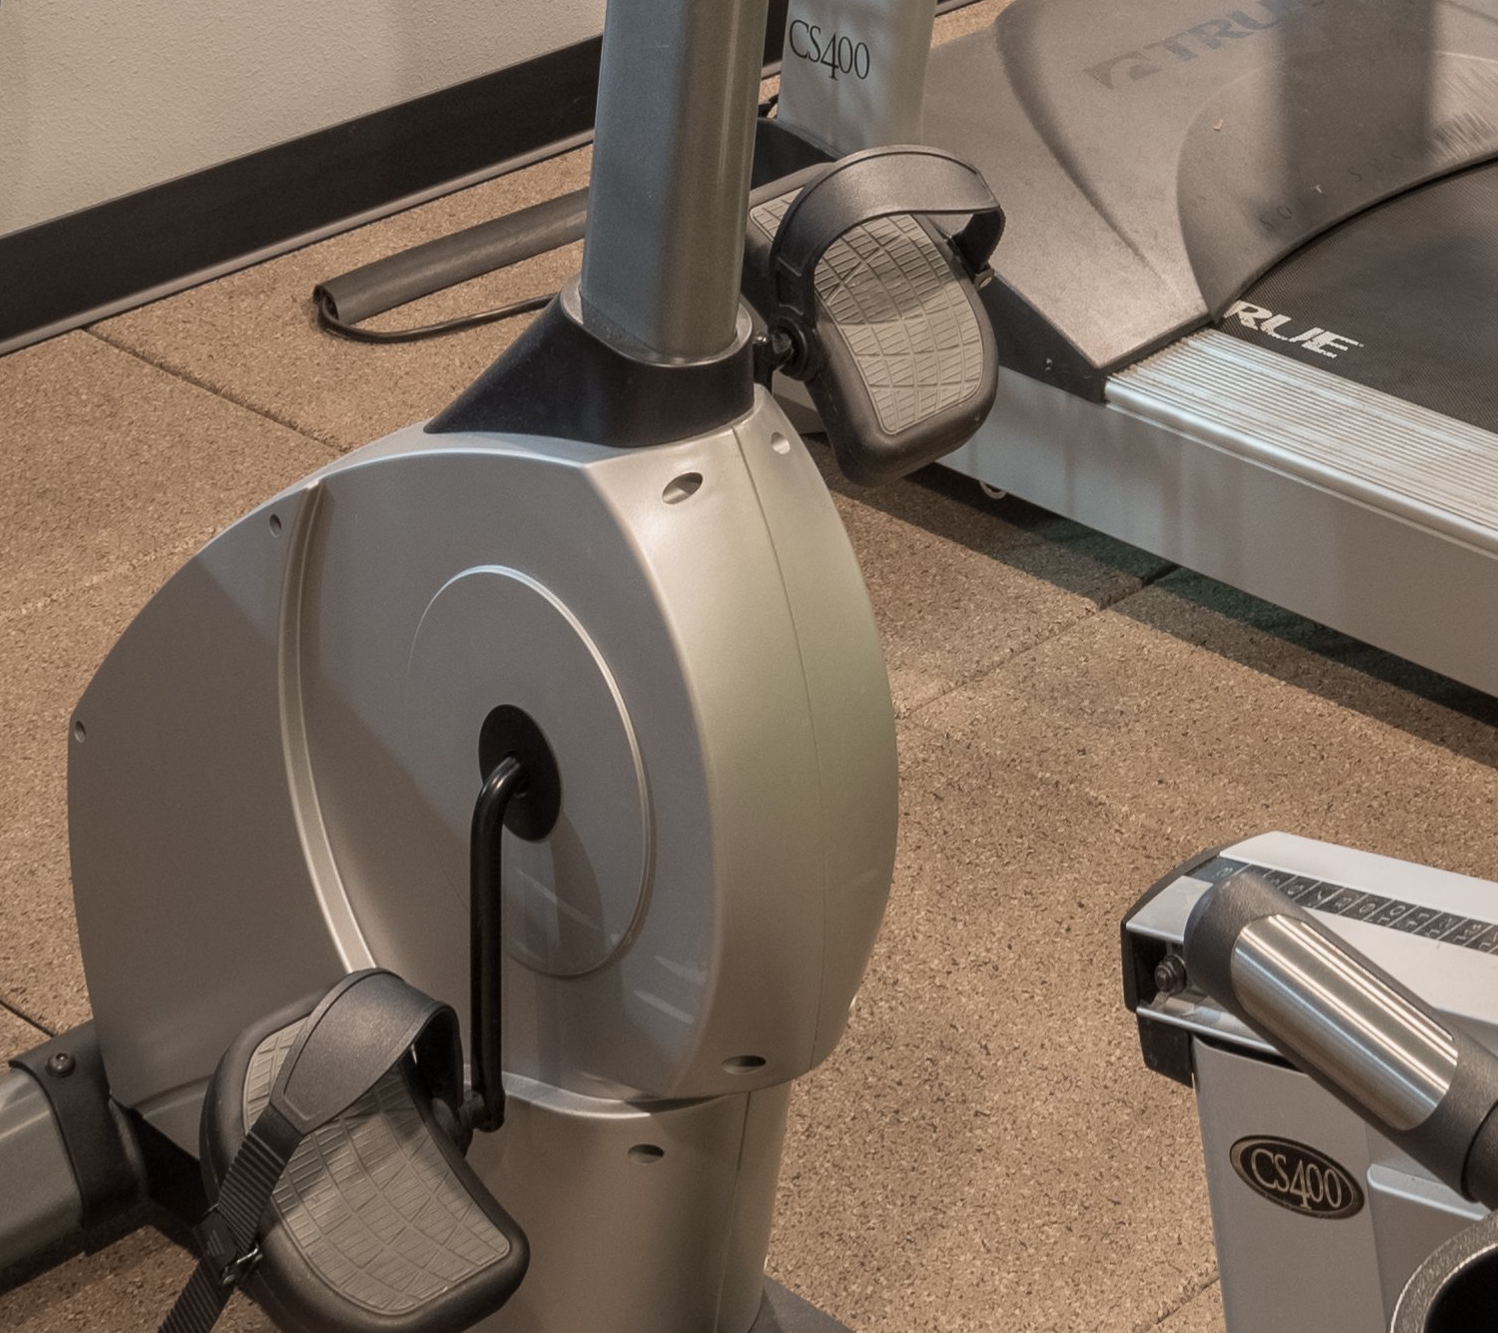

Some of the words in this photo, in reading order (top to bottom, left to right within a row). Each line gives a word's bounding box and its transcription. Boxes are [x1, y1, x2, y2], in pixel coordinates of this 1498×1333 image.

[789, 19, 870, 81] CS400
[1223, 300, 1358, 359] RUE
[1250, 1148, 1342, 1211] CS400
